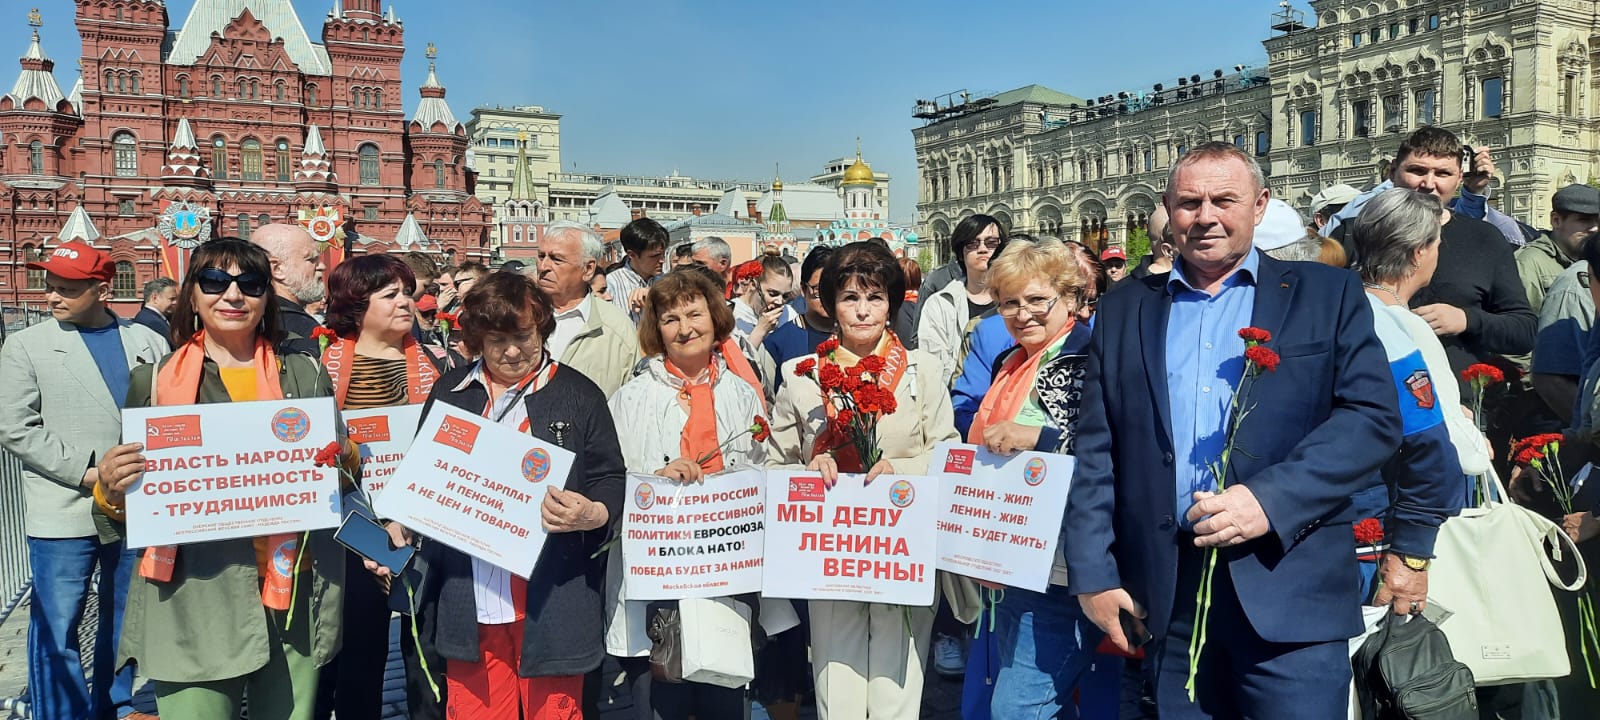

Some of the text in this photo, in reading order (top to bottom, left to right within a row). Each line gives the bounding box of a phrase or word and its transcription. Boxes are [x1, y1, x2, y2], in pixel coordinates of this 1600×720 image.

[144, 453, 229, 472] ВЛАСТЬ
[143, 469, 324, 496] СОБСТВЕННОСТЬ
[369, 482, 384, 491] ЗН
[434, 459, 532, 505] ЗА РОСТ ЗАРПЛАТ
[166, 491, 318, 517] ТРУДЯЩИМСЯ!
[446, 481, 505, 512] И ПЕНСИИ,
[712, 486, 758, 502] РОССИИ
[953, 485, 995, 500] ЛЕНИН
[1004, 493, 1034, 506] ЖИЛ!
[407, 482, 416, 492] А
[418, 486, 436, 500] НЕ
[436, 494, 462, 511] ЦЕН
[462, 505, 472, 516] И
[474, 510, 530, 540] ТОВАРОВ!
[628, 502, 764, 524] ПРОТИВ АГРЕССИВНОЙ
[777, 504, 902, 528] МЫ ДЕЛУ
[950, 504, 991, 520] ЛЕНИН
[998, 512, 1028, 526] ЖИВ!
[628, 521, 764, 540] ПОЛИТИКИ ЕВРОСОЮЗА
[936, 520, 963, 534] ЕНИН
[972, 527, 1008, 543] БУДЕТ
[1009, 534, 1048, 550] ЖИТЬ!
[648, 540, 745, 556] И БЛОКА НАТО!
[798, 532, 910, 556] ЛЕНИНА
[630, 558, 764, 577] ПОБЕДА БУДЕТ ЗА НАМИ!
[823, 558, 924, 583] ВЕРНЫ!
